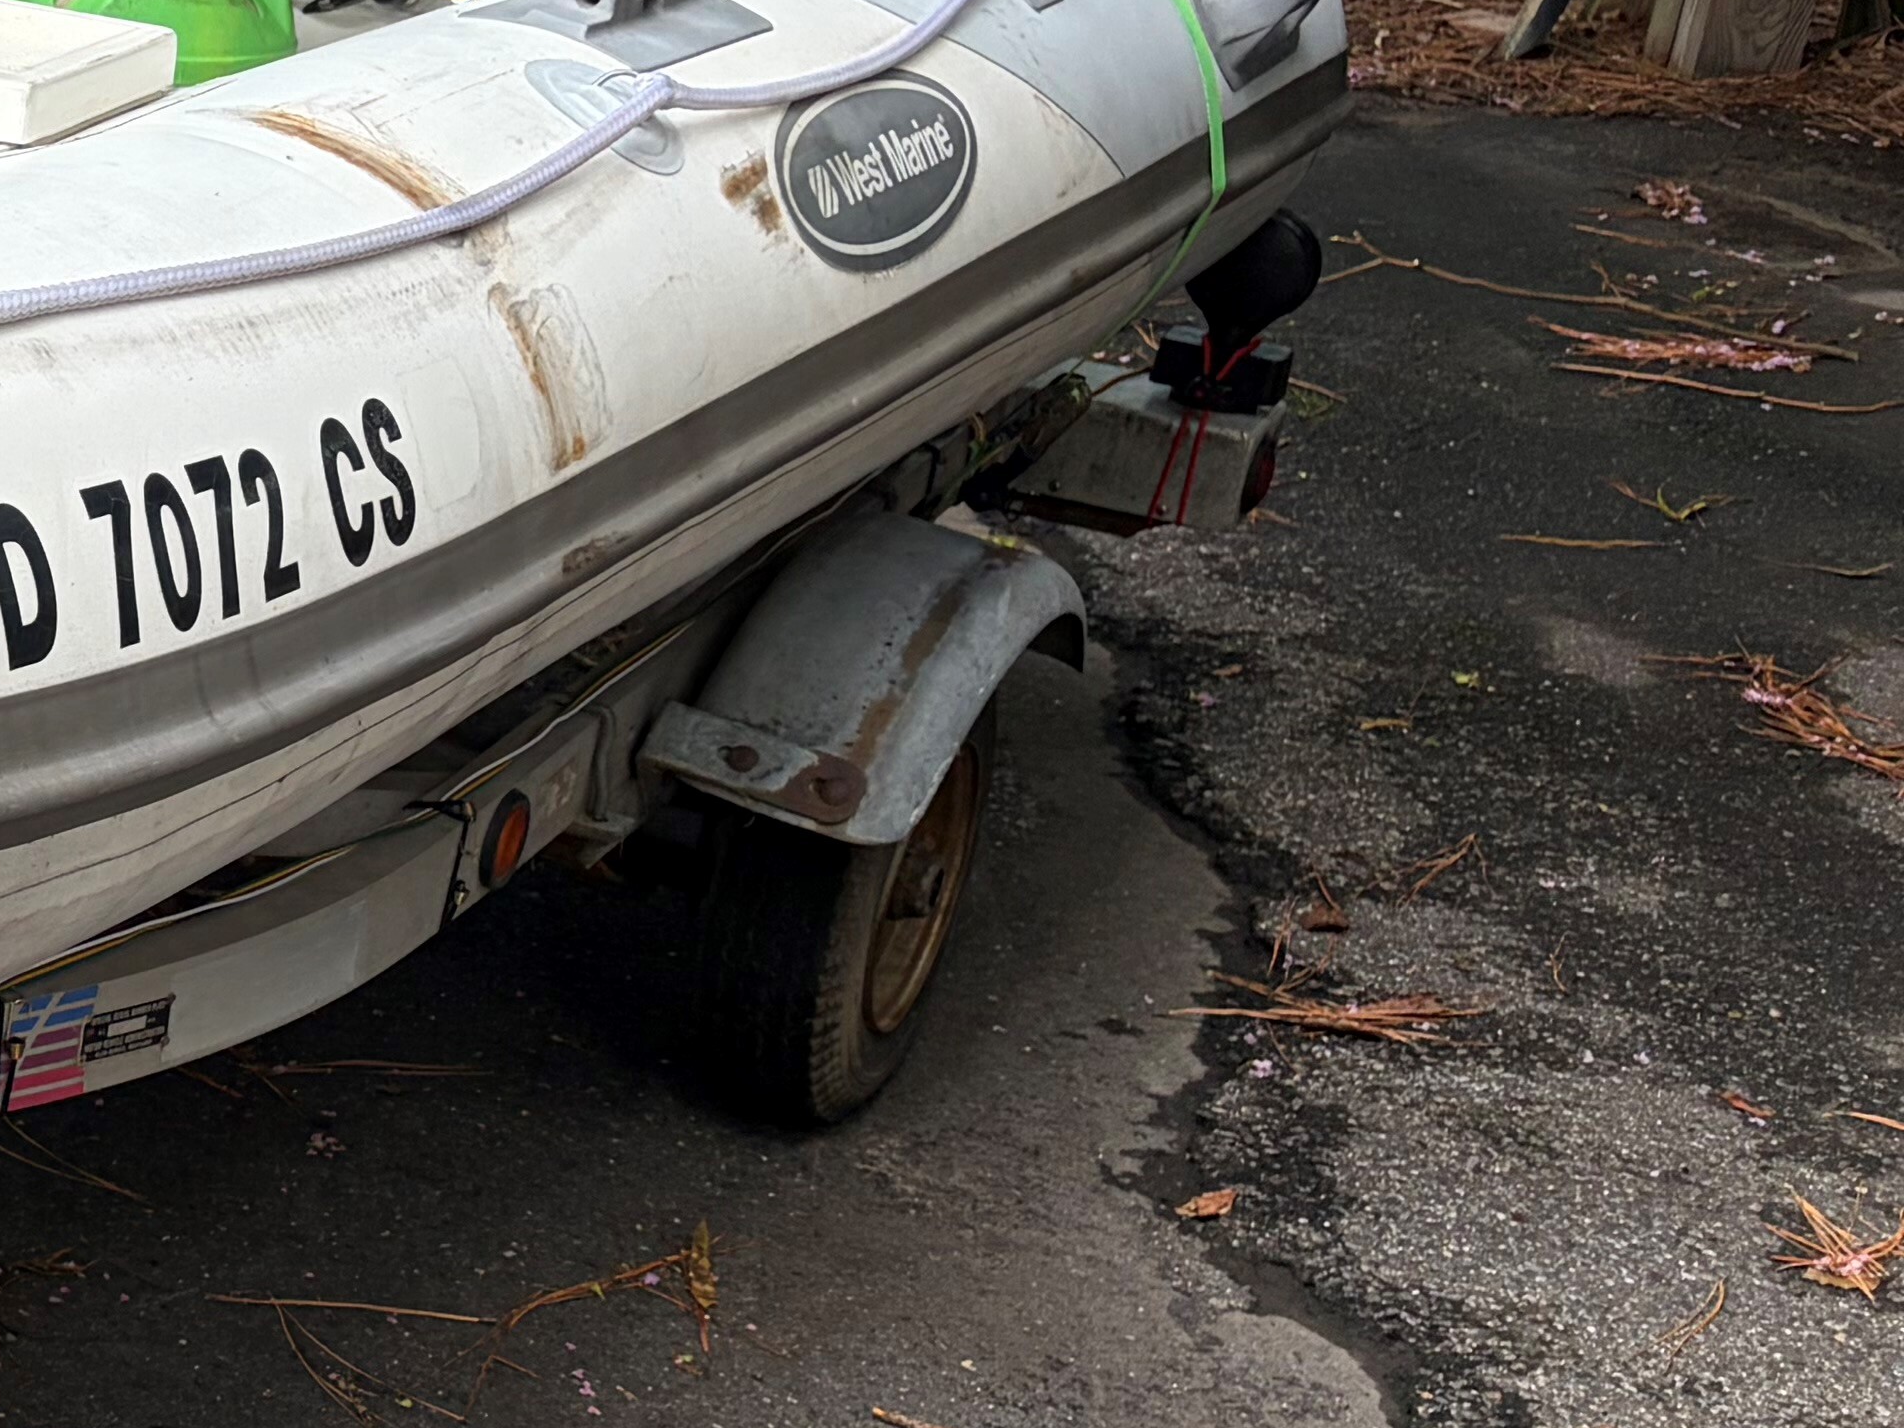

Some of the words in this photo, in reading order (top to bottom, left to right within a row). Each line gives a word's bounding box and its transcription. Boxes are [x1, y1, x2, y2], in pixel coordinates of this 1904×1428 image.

[825, 142, 894, 206] West
[878, 118, 954, 183] Marine
[79, 447, 301, 649] 7072
[319, 397, 417, 568] CS
